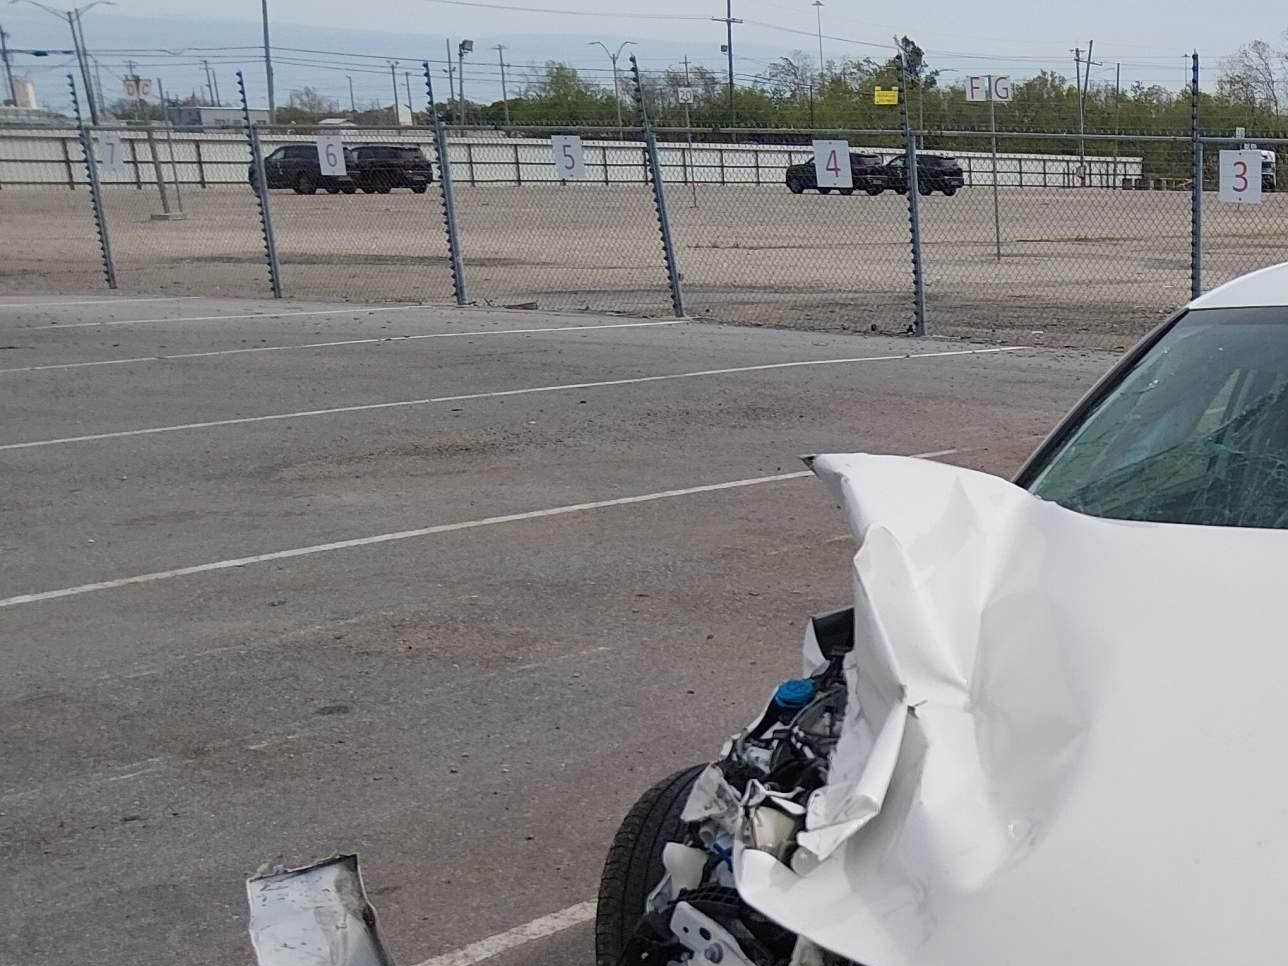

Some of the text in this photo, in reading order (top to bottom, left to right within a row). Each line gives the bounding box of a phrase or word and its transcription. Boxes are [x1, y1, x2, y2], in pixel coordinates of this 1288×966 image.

[142, 82, 151, 97] C
[970, 77, 980, 99] F
[994, 76, 1009, 99] G
[105, 142, 114, 164] 7
[325, 143, 337, 167] 6
[562, 144, 575, 169] 5
[826, 150, 841, 177] 4
[1232, 161, 1248, 192] 3
